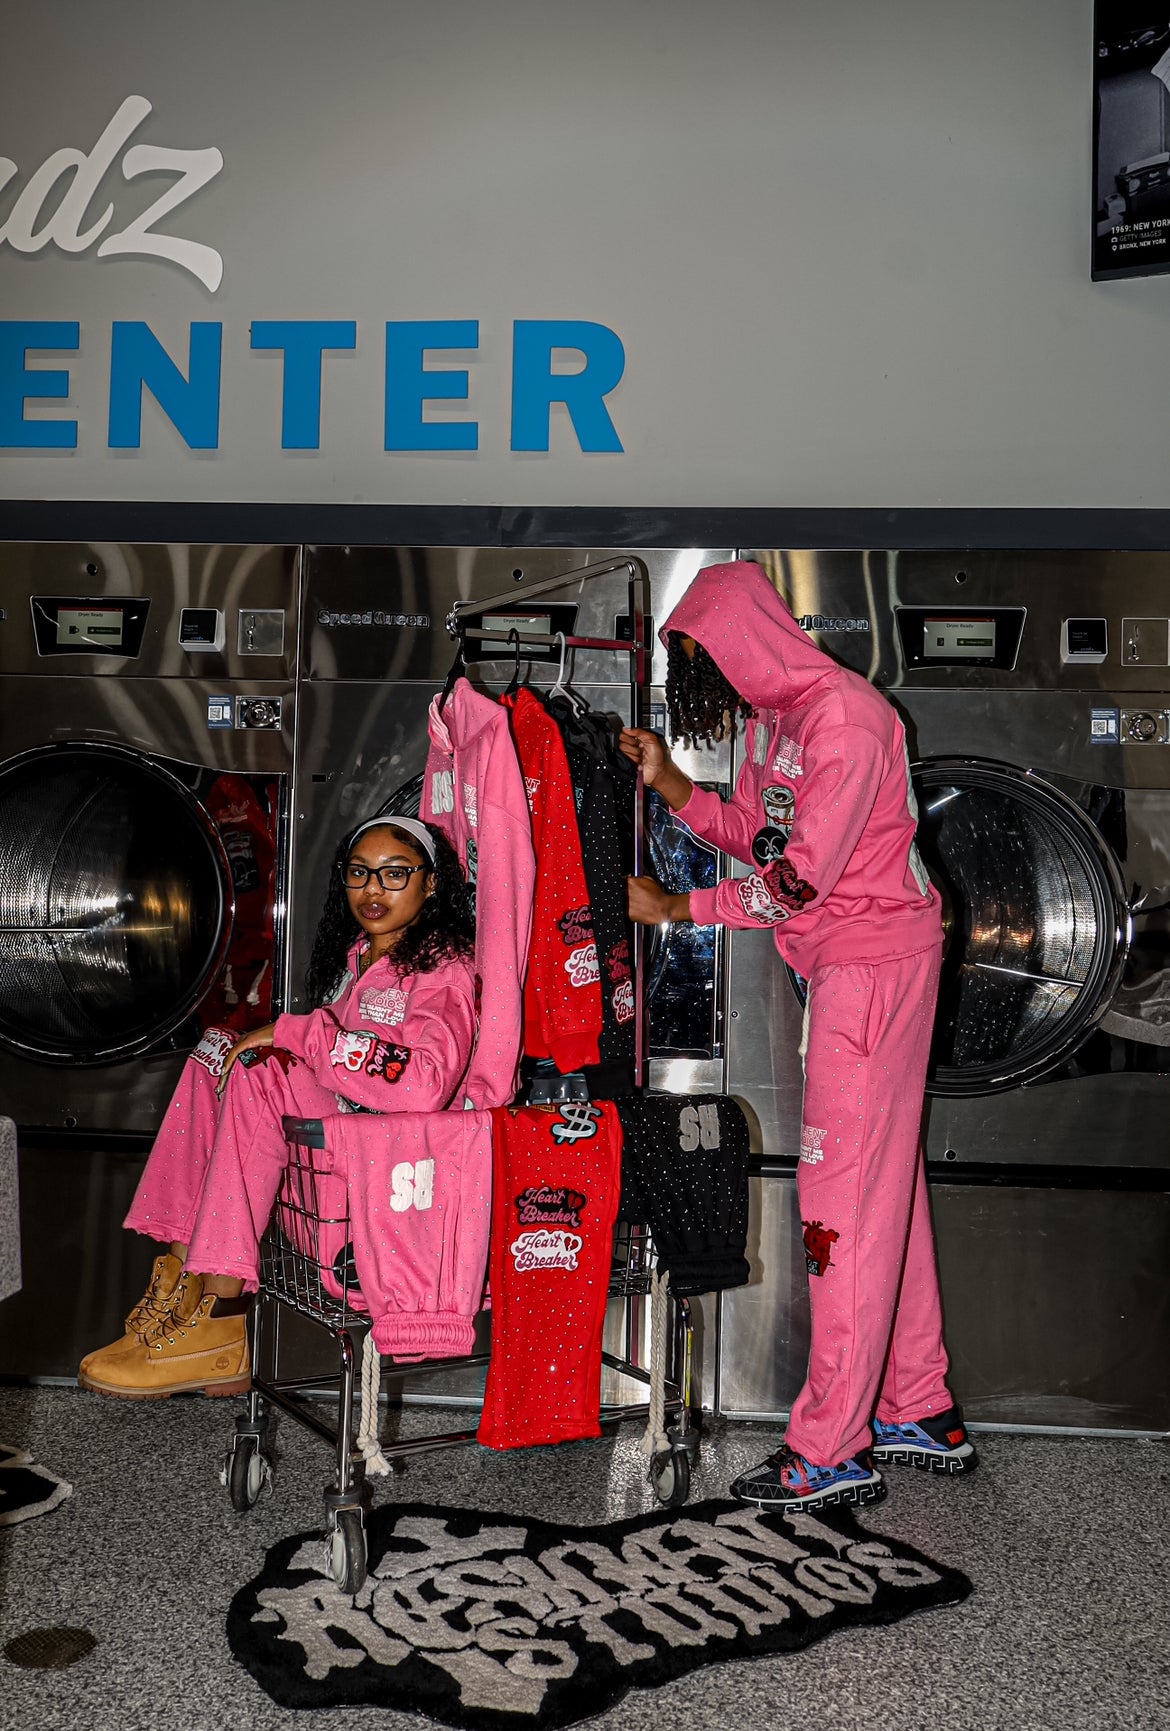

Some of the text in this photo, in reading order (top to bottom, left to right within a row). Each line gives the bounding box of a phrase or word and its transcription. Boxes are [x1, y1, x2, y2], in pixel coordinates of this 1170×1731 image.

[0, 95, 224, 293] dz
[1111, 225, 1132, 234] 1969:
[1133, 222, 1150, 231] NEW
[1119, 233, 1138, 241] GETTY
[0, 320, 625, 453] ENTER
[318, 610, 430, 627] Speed Queen
[811, 615, 869, 631] Queen
[519, 1187, 566, 1207] Heart
[520, 1205, 579, 1227] Breaker
[515, 1231, 562, 1254] Heart
[516, 1251, 577, 1269] Breaker
